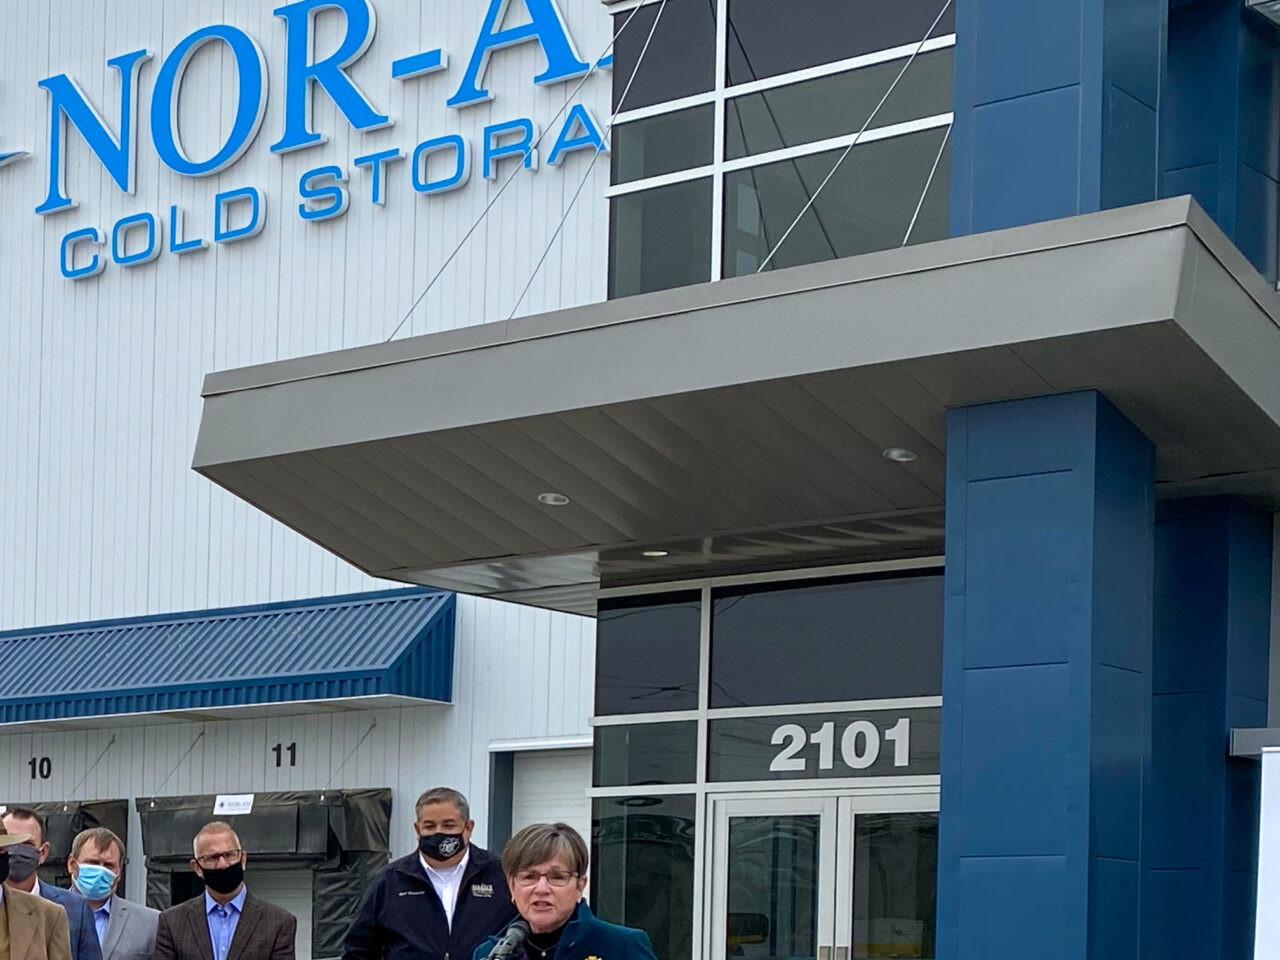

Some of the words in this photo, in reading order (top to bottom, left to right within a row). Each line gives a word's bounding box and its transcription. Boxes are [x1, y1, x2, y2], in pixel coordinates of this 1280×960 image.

[35, 0, 613, 215] NOR-A
[60, 186, 267, 282] COLD
[27, 756, 53, 782] 10
[271, 742, 298, 768] 11
[769, 716, 910, 772] 2101
